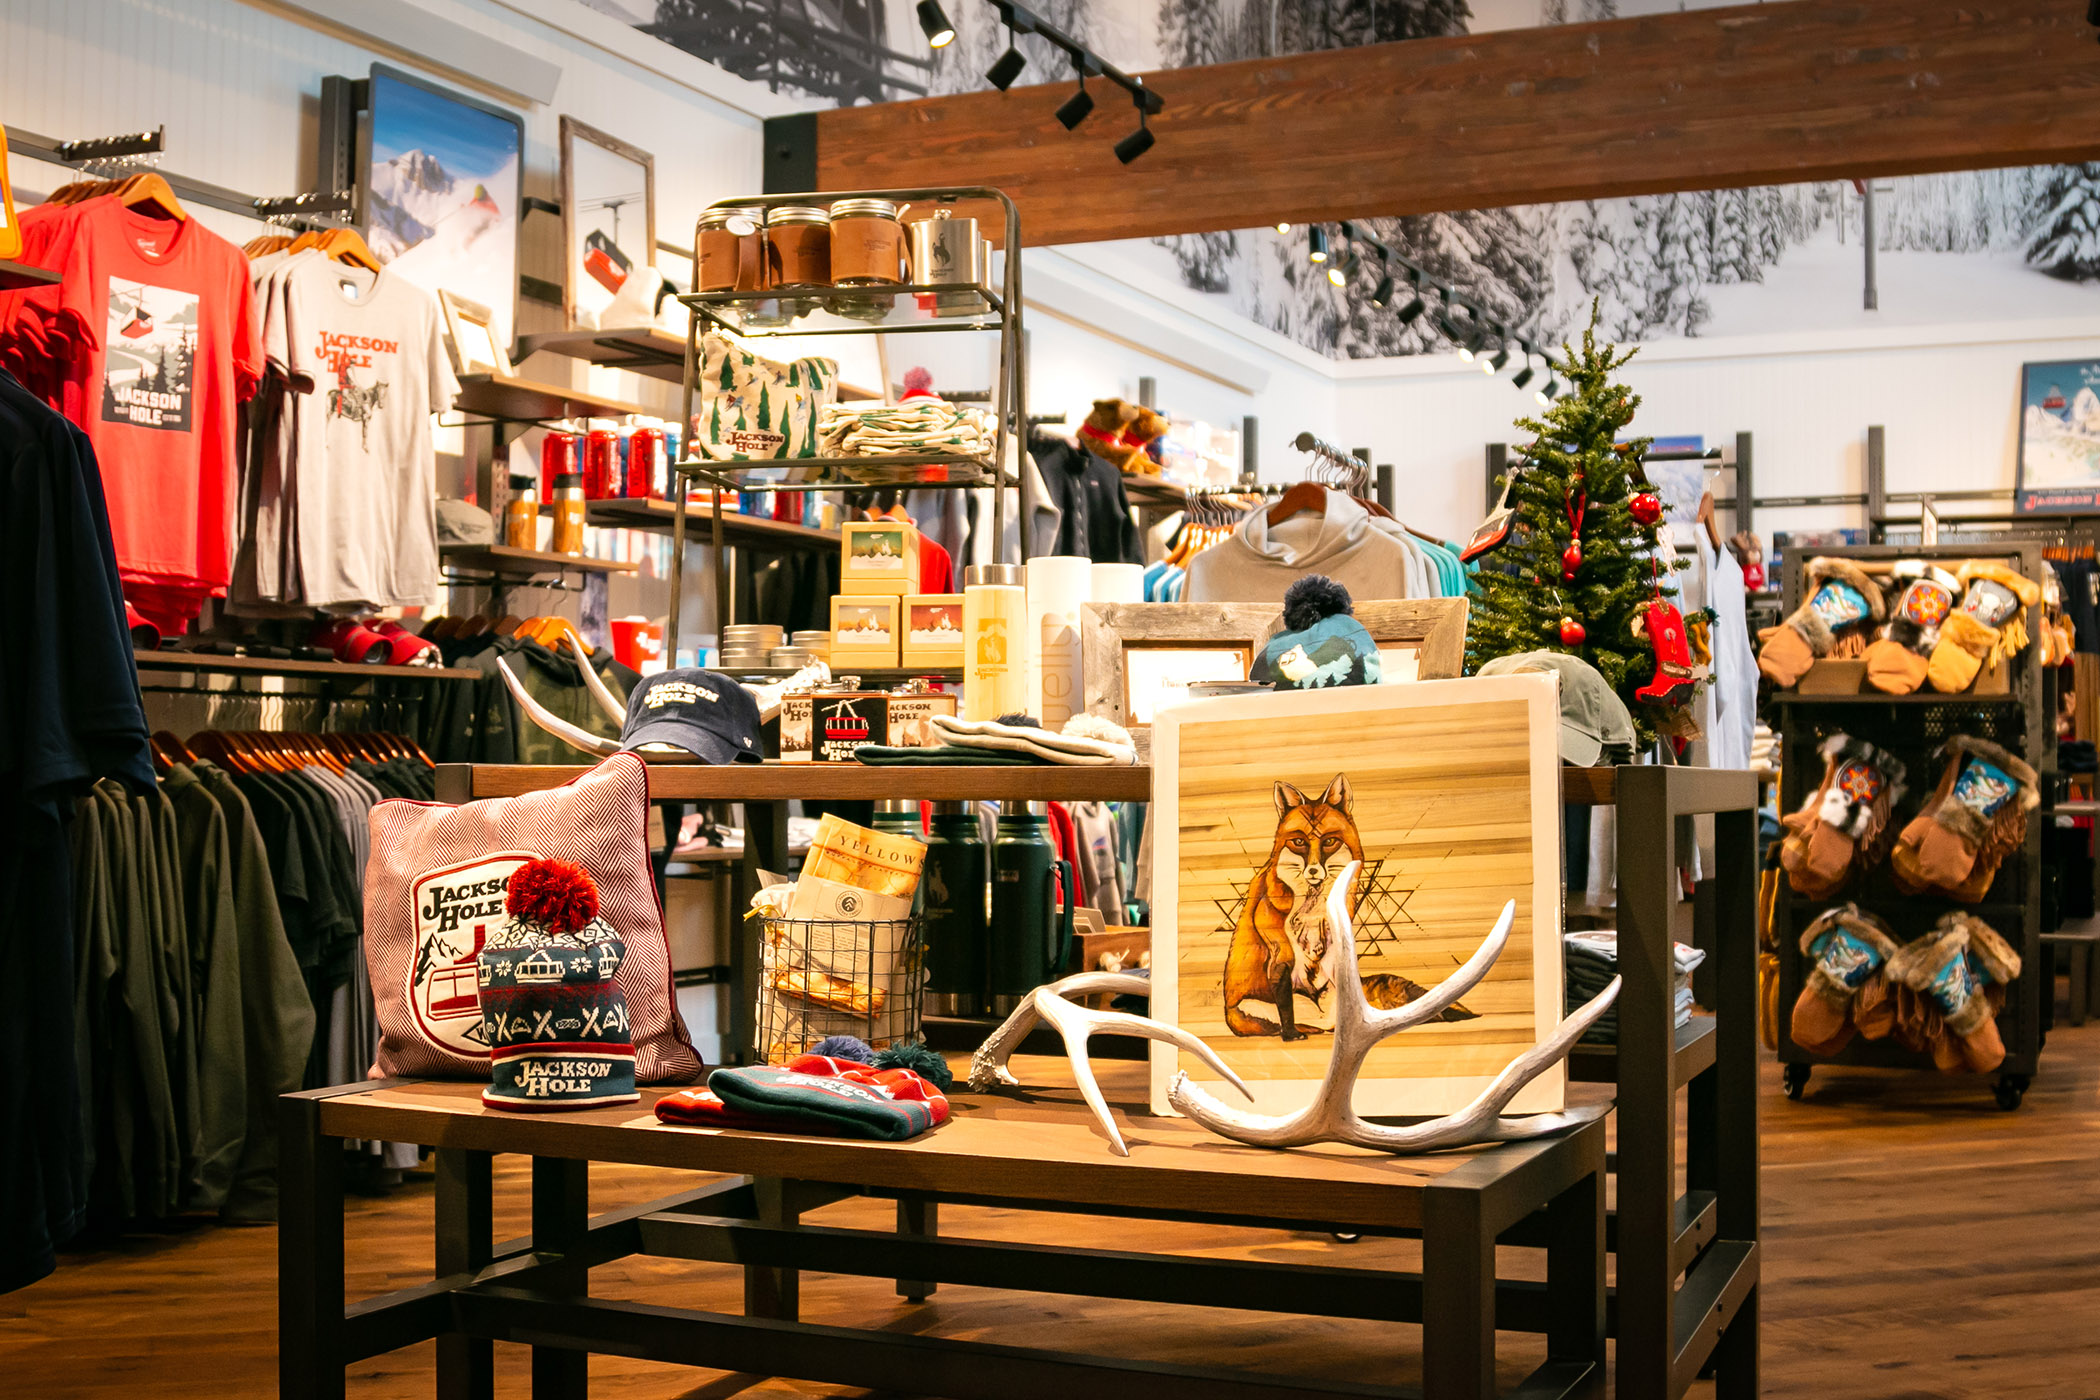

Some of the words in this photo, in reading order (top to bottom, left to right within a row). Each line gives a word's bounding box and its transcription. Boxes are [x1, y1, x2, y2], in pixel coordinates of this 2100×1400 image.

[315, 330, 399, 359] JACKSON
[114, 386, 182, 410] JACKSON
[129, 404, 163, 425] HOLE
[725, 431, 784, 446] JACKSON
[736, 441, 768, 453] HOLE
[643, 682, 720, 705] JACKSON
[648, 692, 696, 710] HOLE
[783, 701, 812, 716] JACK
[790, 709, 812, 721] HO
[889, 703, 931, 711] ACKSON
[889, 712, 919, 724] HOLE
[828, 749, 855, 761] HOL
[422, 876, 509, 920] JACKSO
[437, 899, 503, 933] HOLE
[514, 1060, 612, 1087] JACKSON
[526, 1077, 591, 1096] HOLE
